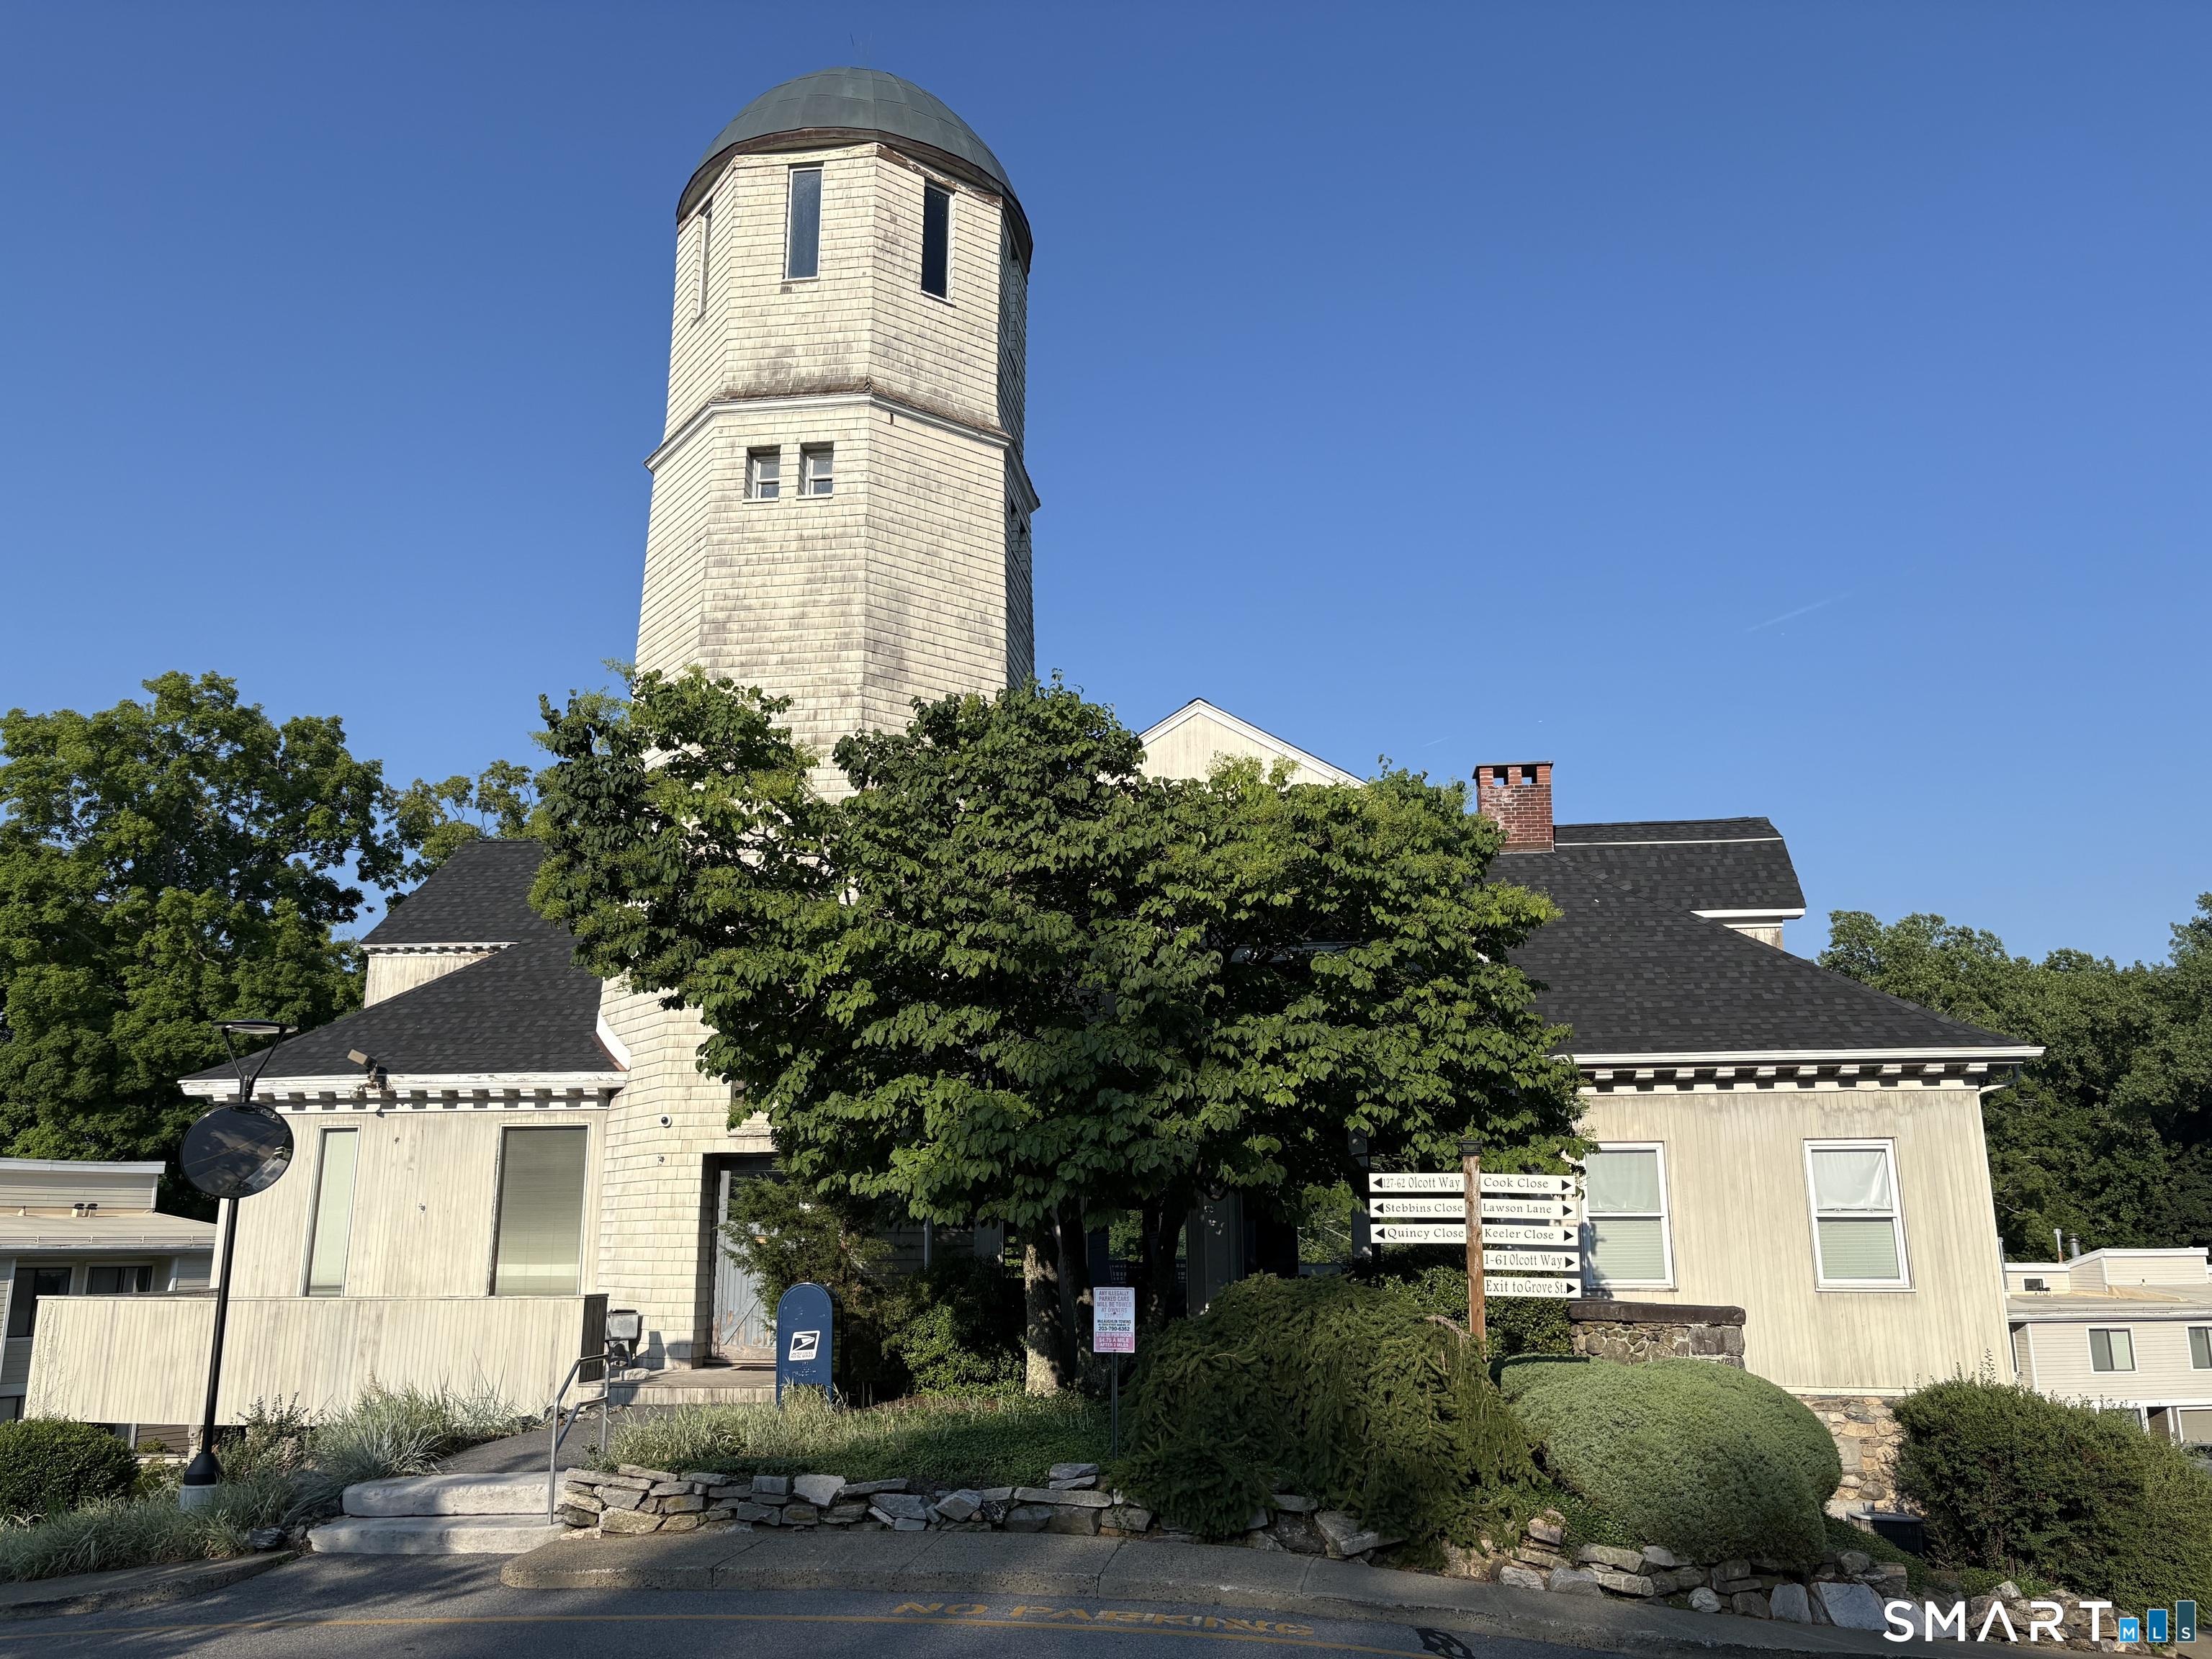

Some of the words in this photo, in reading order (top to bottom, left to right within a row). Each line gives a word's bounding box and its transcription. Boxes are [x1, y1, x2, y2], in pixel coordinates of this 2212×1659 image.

[1383, 1178, 1406, 1188] 127-62
[1408, 1177, 1436, 1188] Olcott
[1439, 1177, 1460, 1191] Way
[1484, 1177, 1514, 1187] Cook
[1517, 1178, 1549, 1188] Close
[1385, 1203, 1431, 1213] Stebbins
[1434, 1203, 1463, 1213] Close
[1483, 1203, 1523, 1213] Lawson
[1527, 1204, 1552, 1213] Lane
[1388, 1228, 1430, 1240] Quincy
[1434, 1228, 1464, 1238] Close
[1485, 1228, 1521, 1238] Keeler
[1524, 1229, 1555, 1239] Close
[1540, 1254, 1563, 1269] Way
[1485, 1280, 1509, 1292] Exit
[1524, 1280, 1552, 1294] Grove
[1555, 1281, 1566, 1294] St.
[891, 1602, 988, 1615] NO
[1008, 1605, 1314, 1637] PARKING
